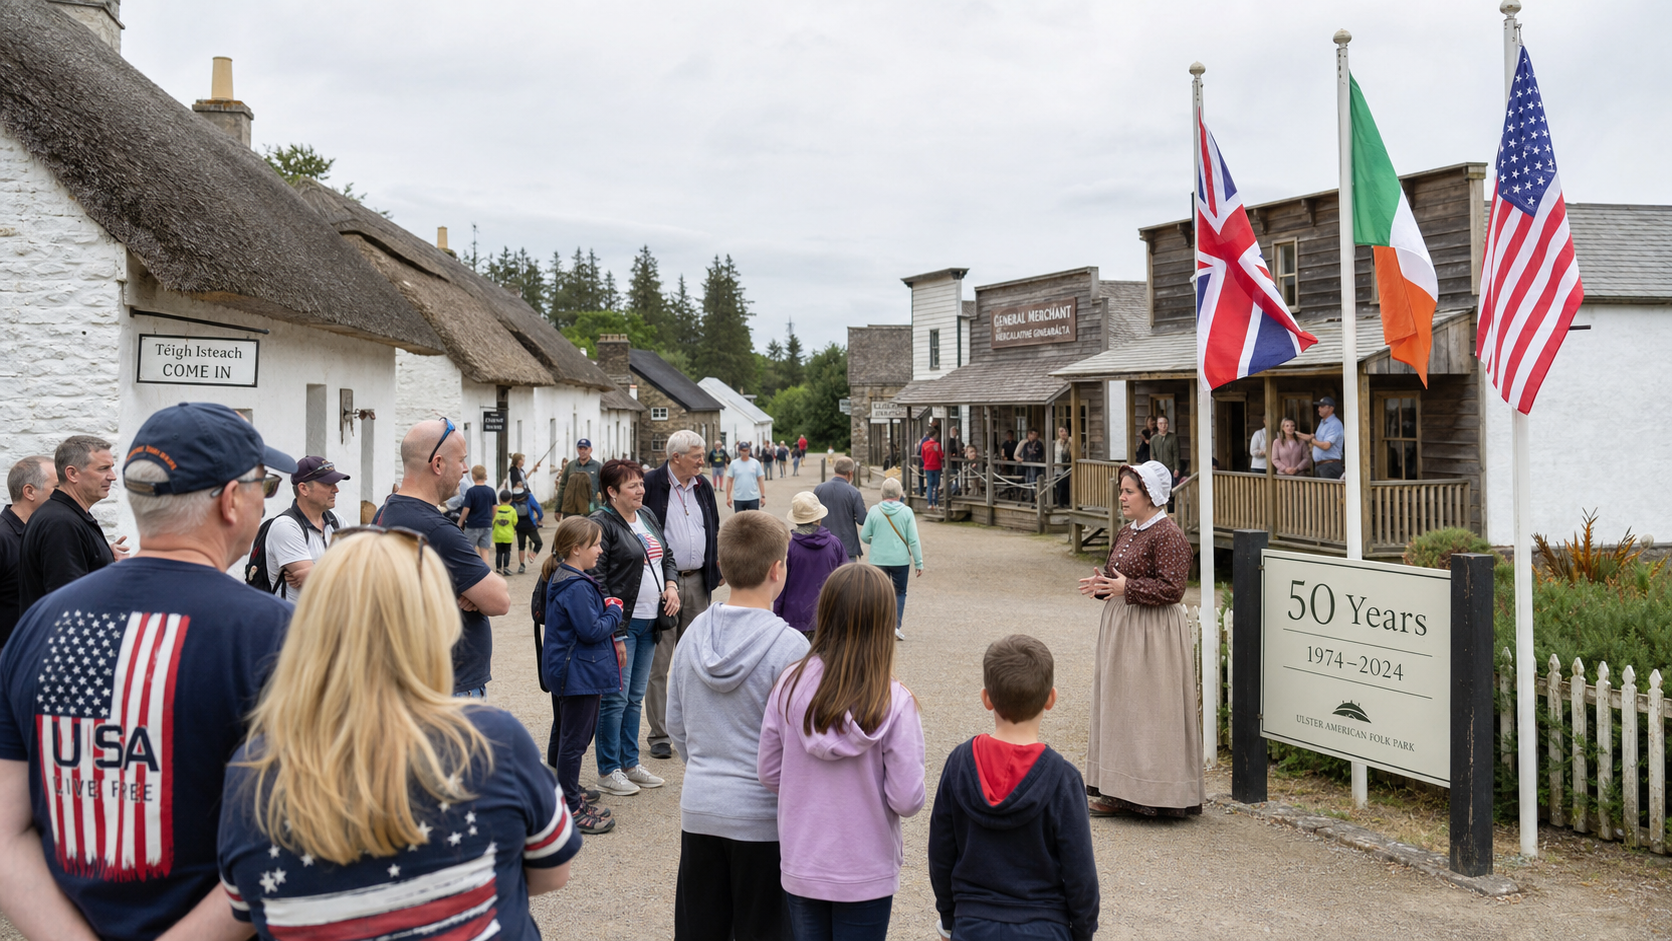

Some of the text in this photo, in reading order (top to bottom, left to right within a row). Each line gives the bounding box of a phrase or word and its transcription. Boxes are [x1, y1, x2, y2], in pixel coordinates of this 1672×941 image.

[993, 304, 1072, 328] GENERAL MERCHANT
[155, 343, 242, 360] Téigh Isteach
[162, 363, 231, 379] COME IN
[1287, 579, 1428, 636] 50 Years
[1296, 714, 1415, 752] ULSTER AMERICAN FOLK PARK
[52, 721, 160, 772] USA
[53, 776, 153, 802] LIVE FREE
